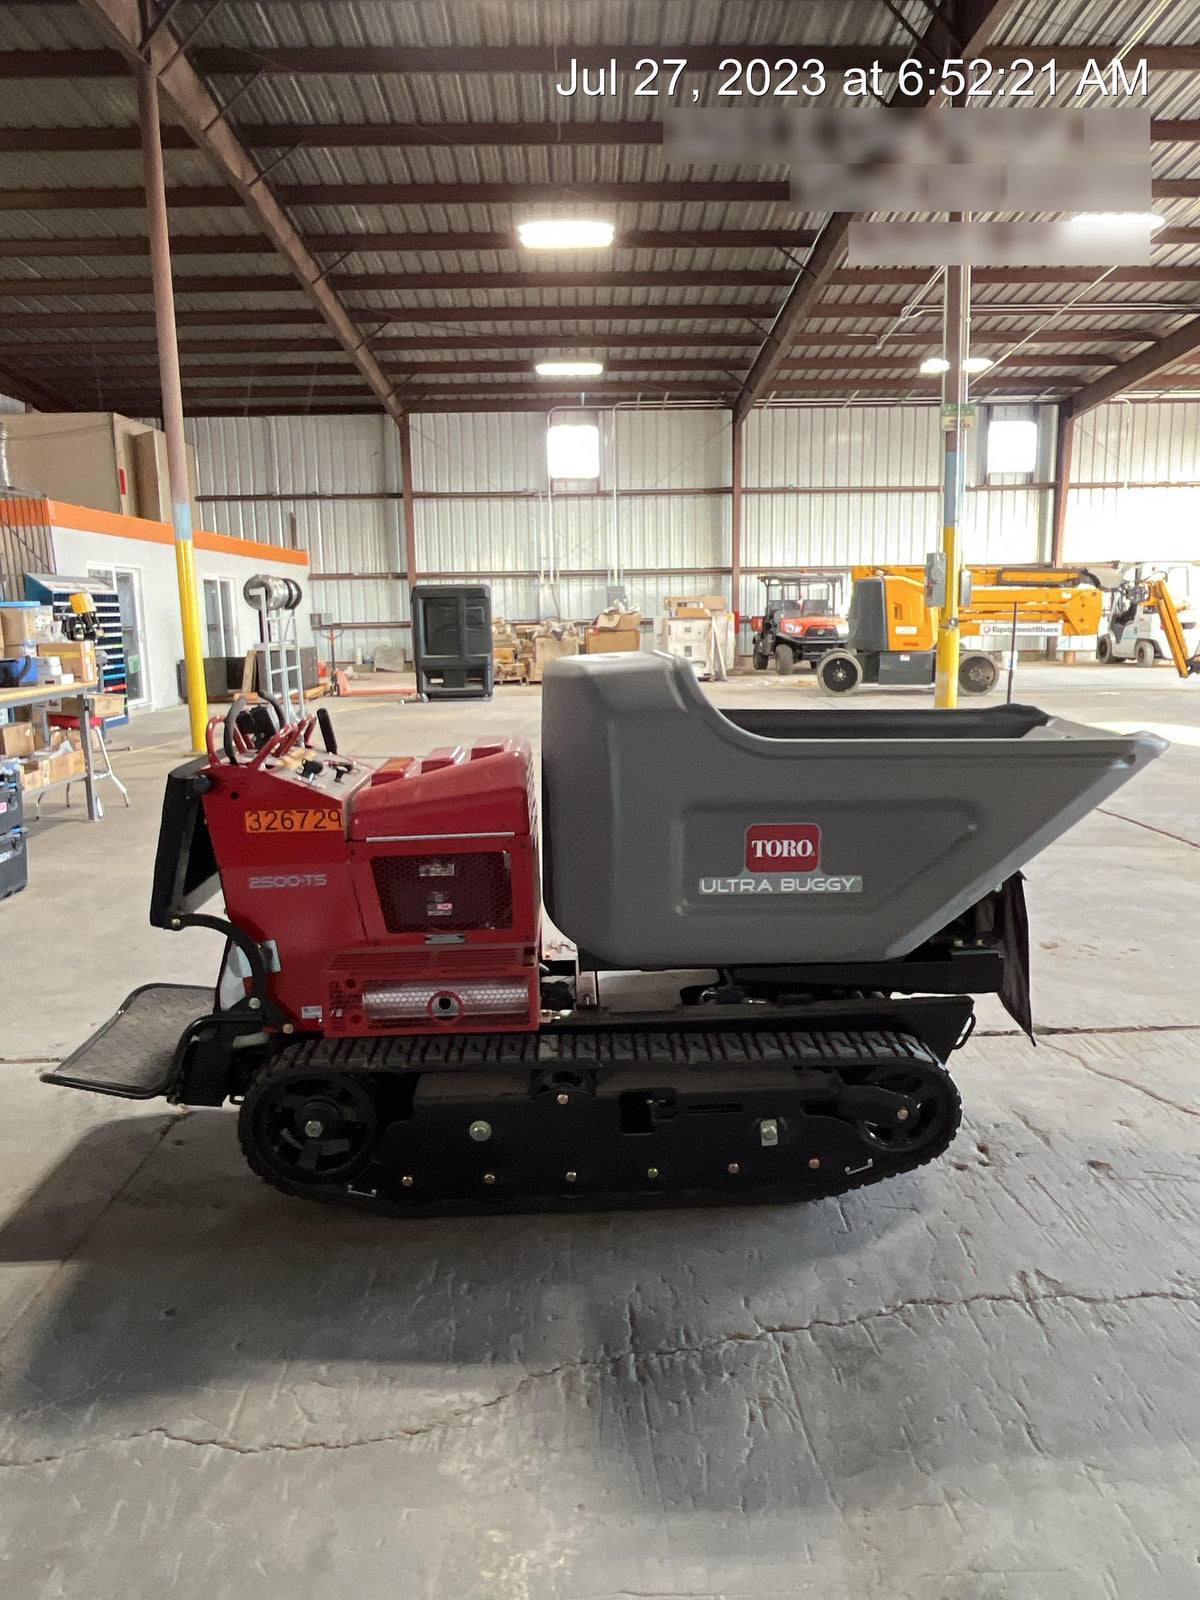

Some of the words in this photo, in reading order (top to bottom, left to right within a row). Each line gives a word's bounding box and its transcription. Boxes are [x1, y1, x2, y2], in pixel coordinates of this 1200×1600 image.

[248, 809, 342, 831] 326729
[751, 839, 814, 858] TORO
[701, 879, 773, 893] ULTRA
[780, 877, 856, 892] BUGGY
